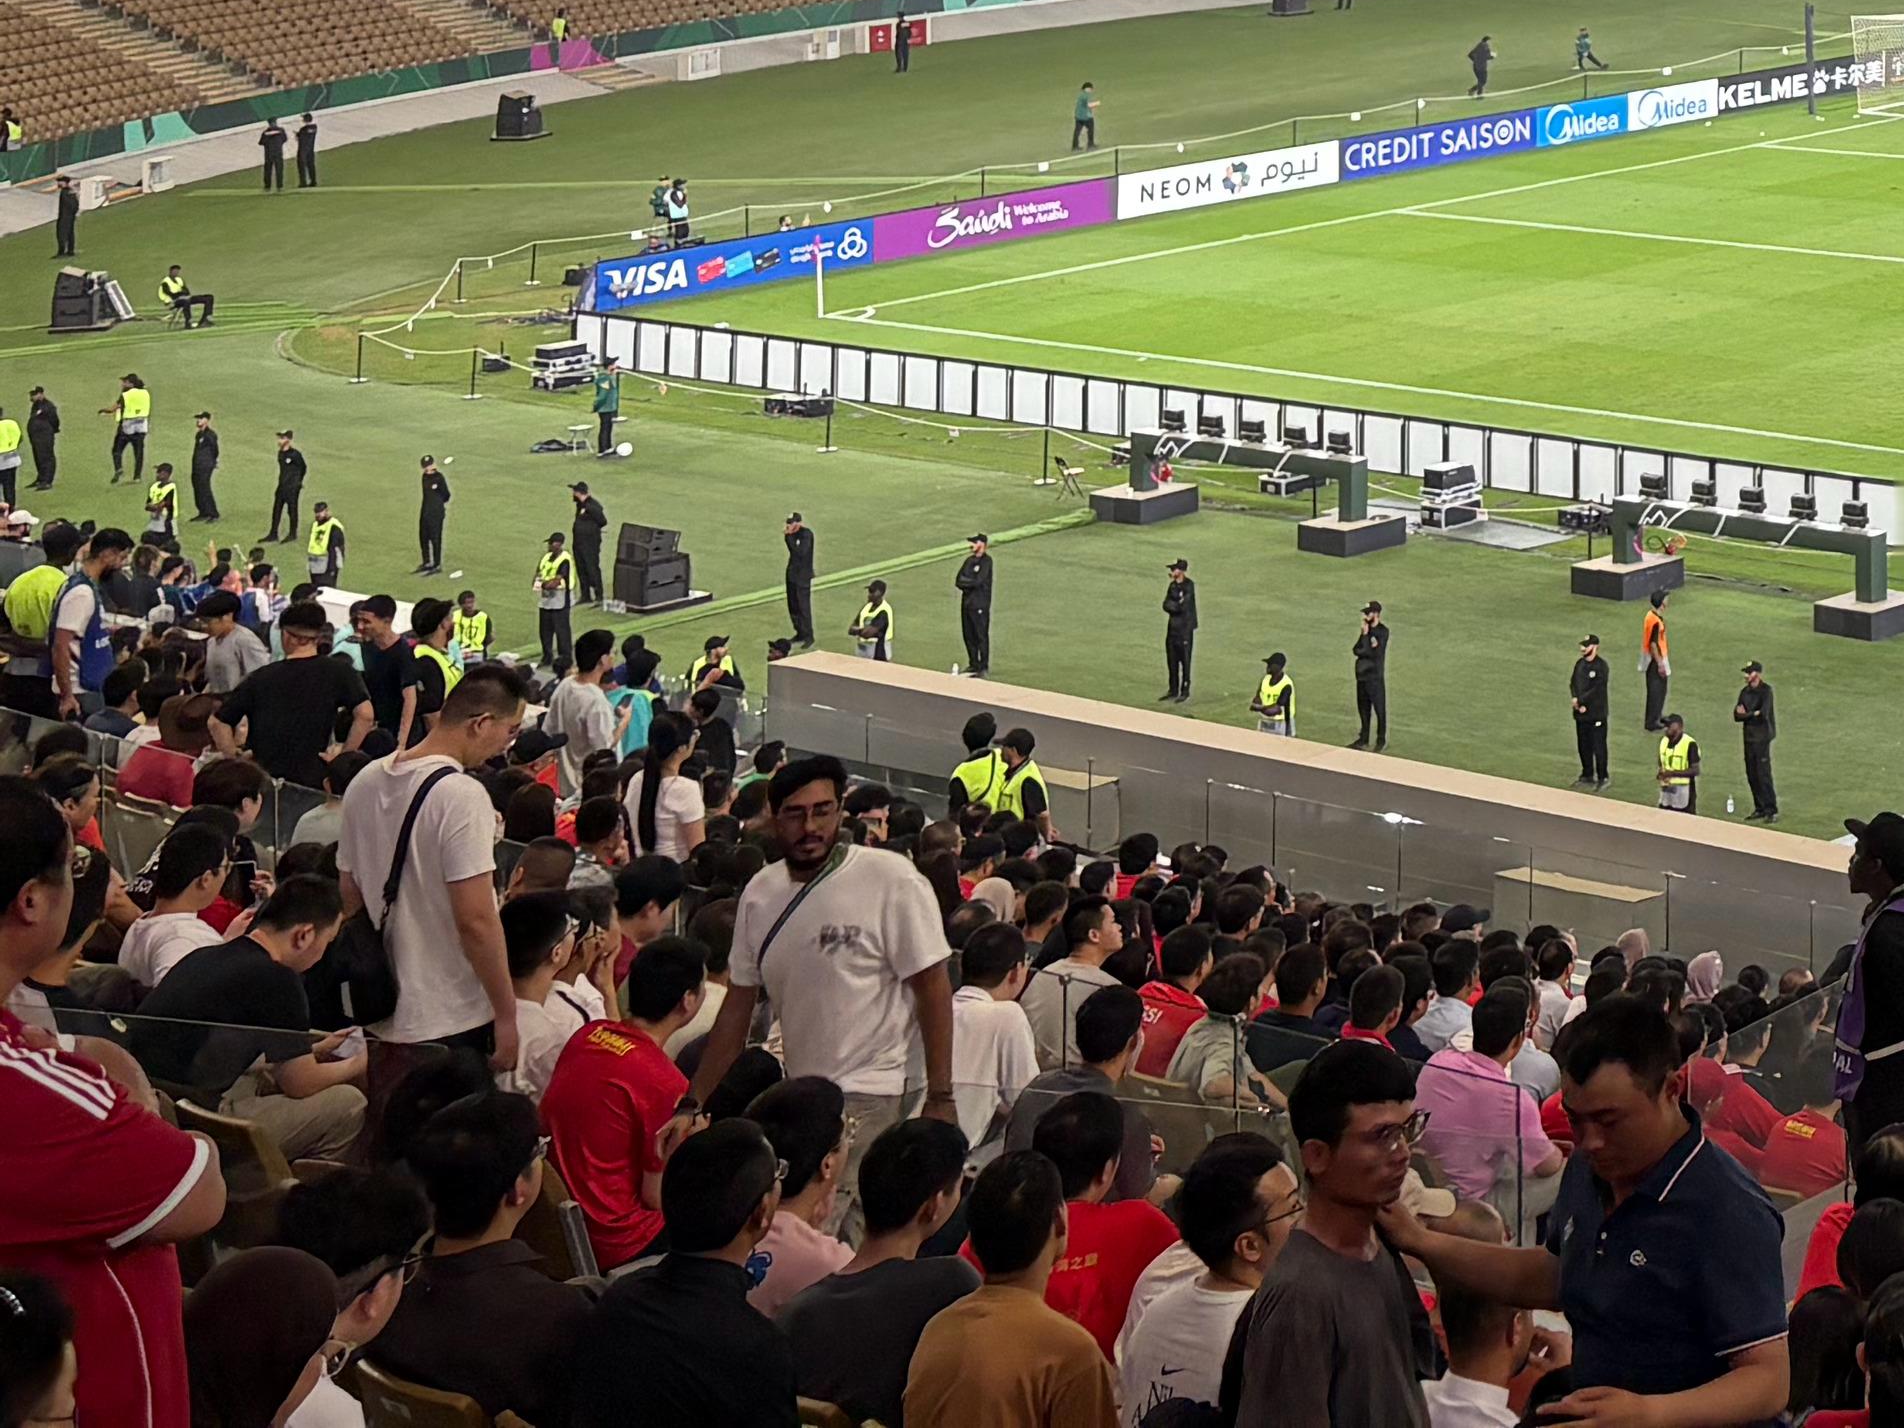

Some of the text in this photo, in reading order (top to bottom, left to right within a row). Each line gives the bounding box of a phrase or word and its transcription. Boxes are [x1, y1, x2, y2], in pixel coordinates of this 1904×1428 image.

[1718, 72, 1809, 111] KELME
[1831, 60, 1883, 90] 卡尔美
[1548, 106, 1619, 142] Midea
[1641, 93, 1707, 126] Midea
[1344, 116, 1531, 172] CREDIT SAISON
[1261, 151, 1318, 187] نيوم
[1140, 173, 1211, 203] NEOM
[927, 200, 1013, 248] Saudi
[604, 258, 688, 297] VISA
